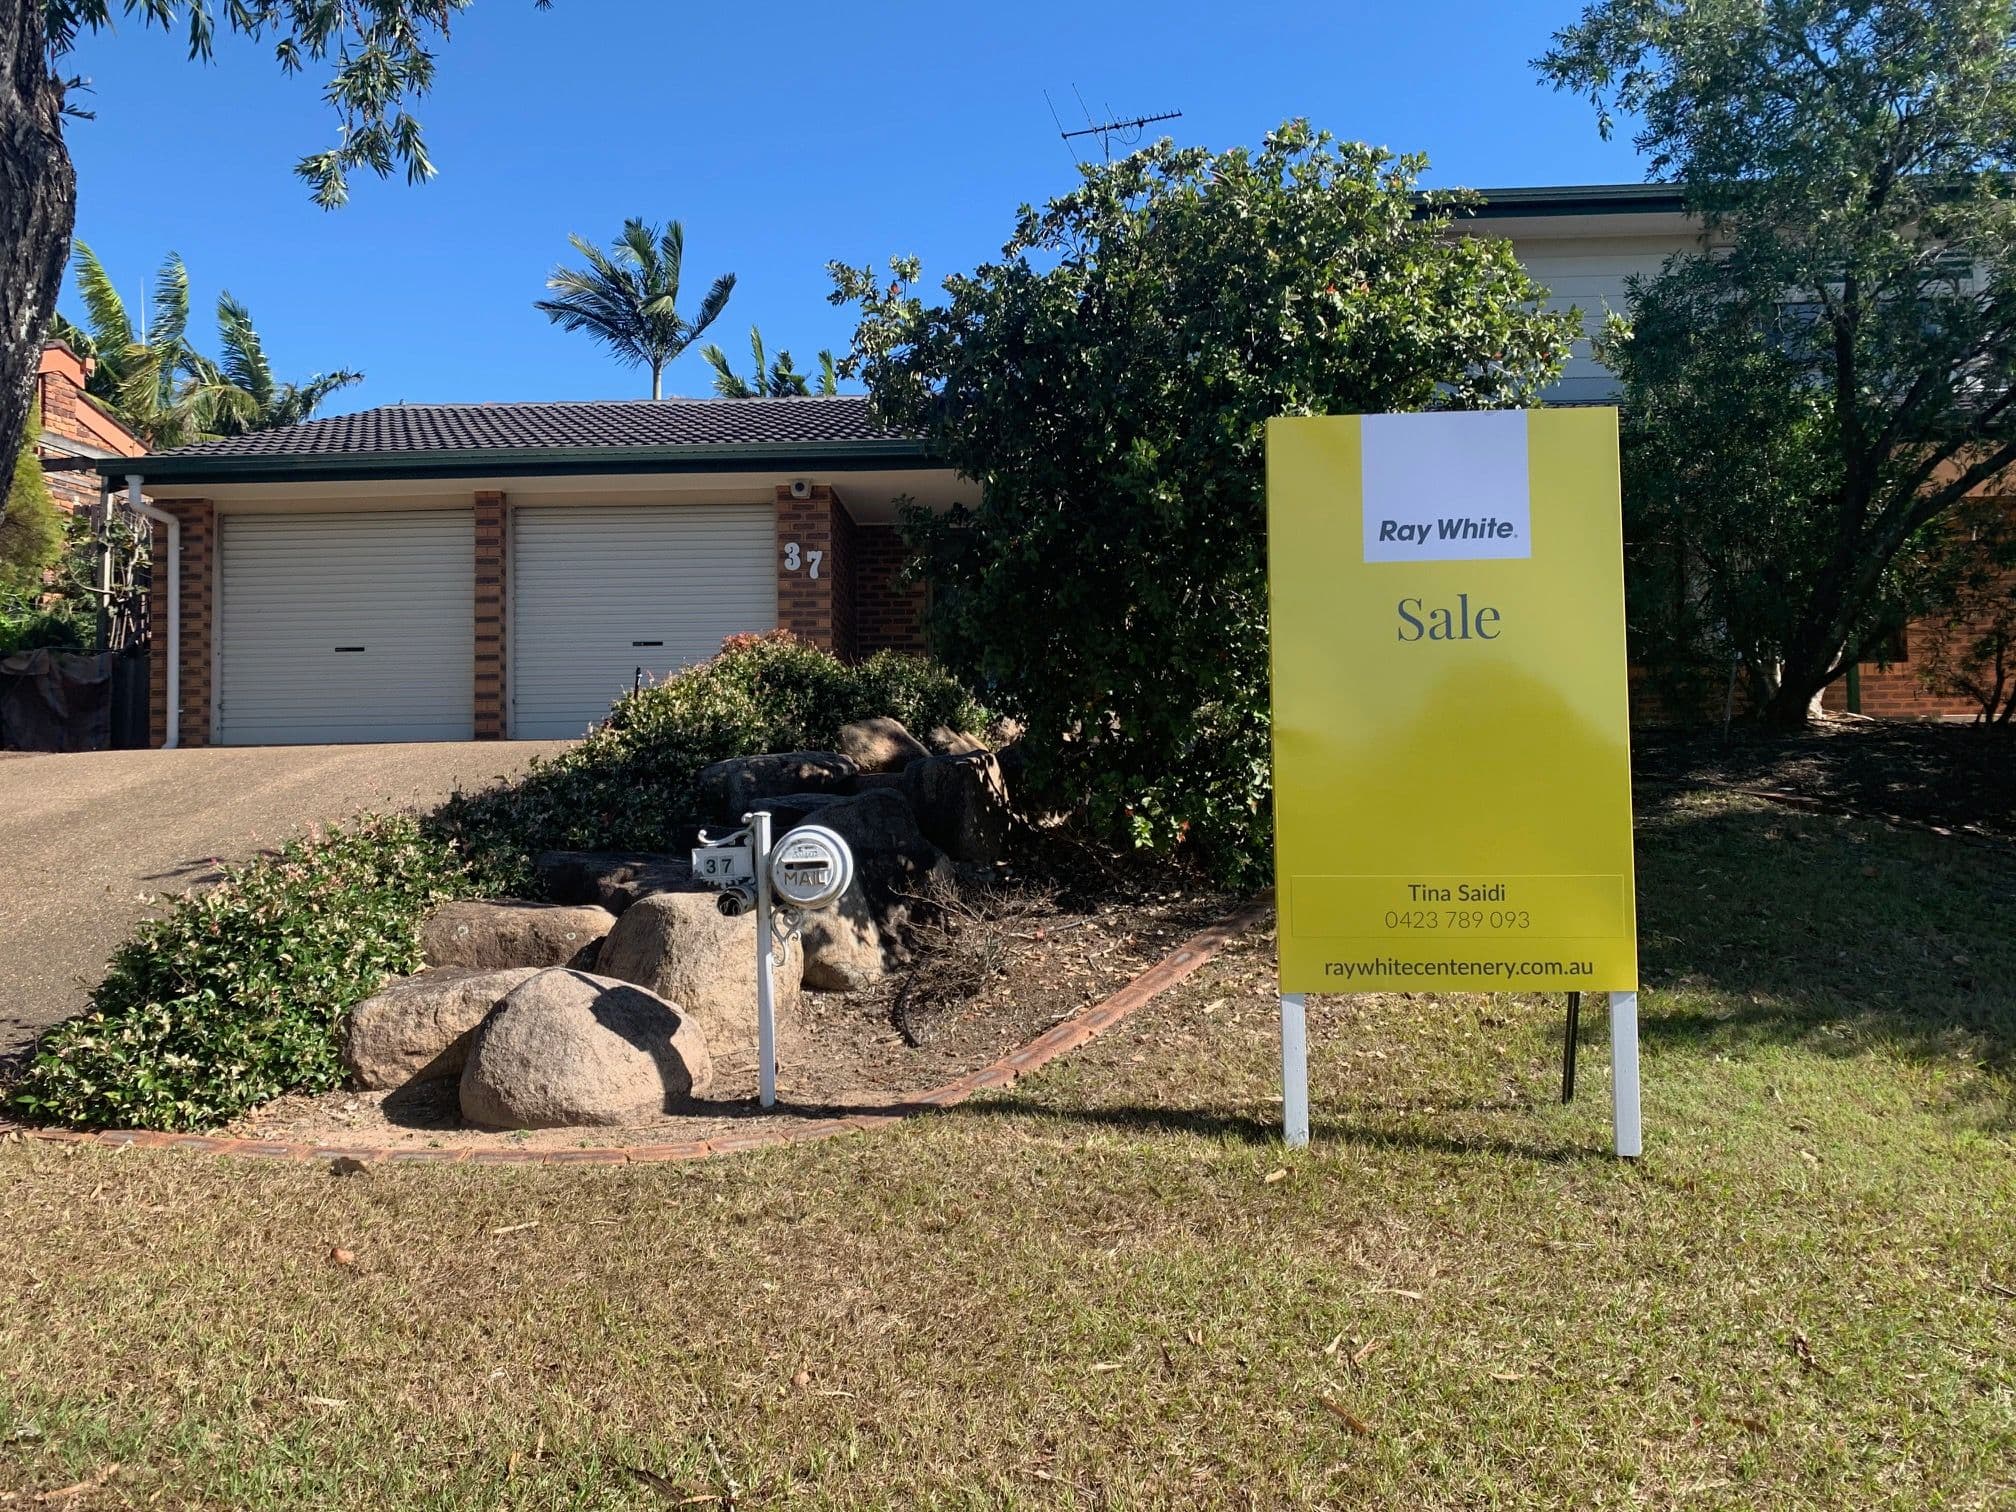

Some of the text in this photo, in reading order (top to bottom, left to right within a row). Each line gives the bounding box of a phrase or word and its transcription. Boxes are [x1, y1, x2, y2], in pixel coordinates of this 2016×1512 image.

[1379, 520, 1432, 545] Ray
[784, 542, 823, 579] 37
[1398, 594, 1501, 642] Sale
[706, 858, 733, 874] 37
[784, 871, 827, 886] MAIL
[1408, 884, 1506, 902] Tina Saidi
[1384, 911, 1531, 928] 0423 789 093
[1324, 957, 1594, 980] raywhitecentenery.com.au
